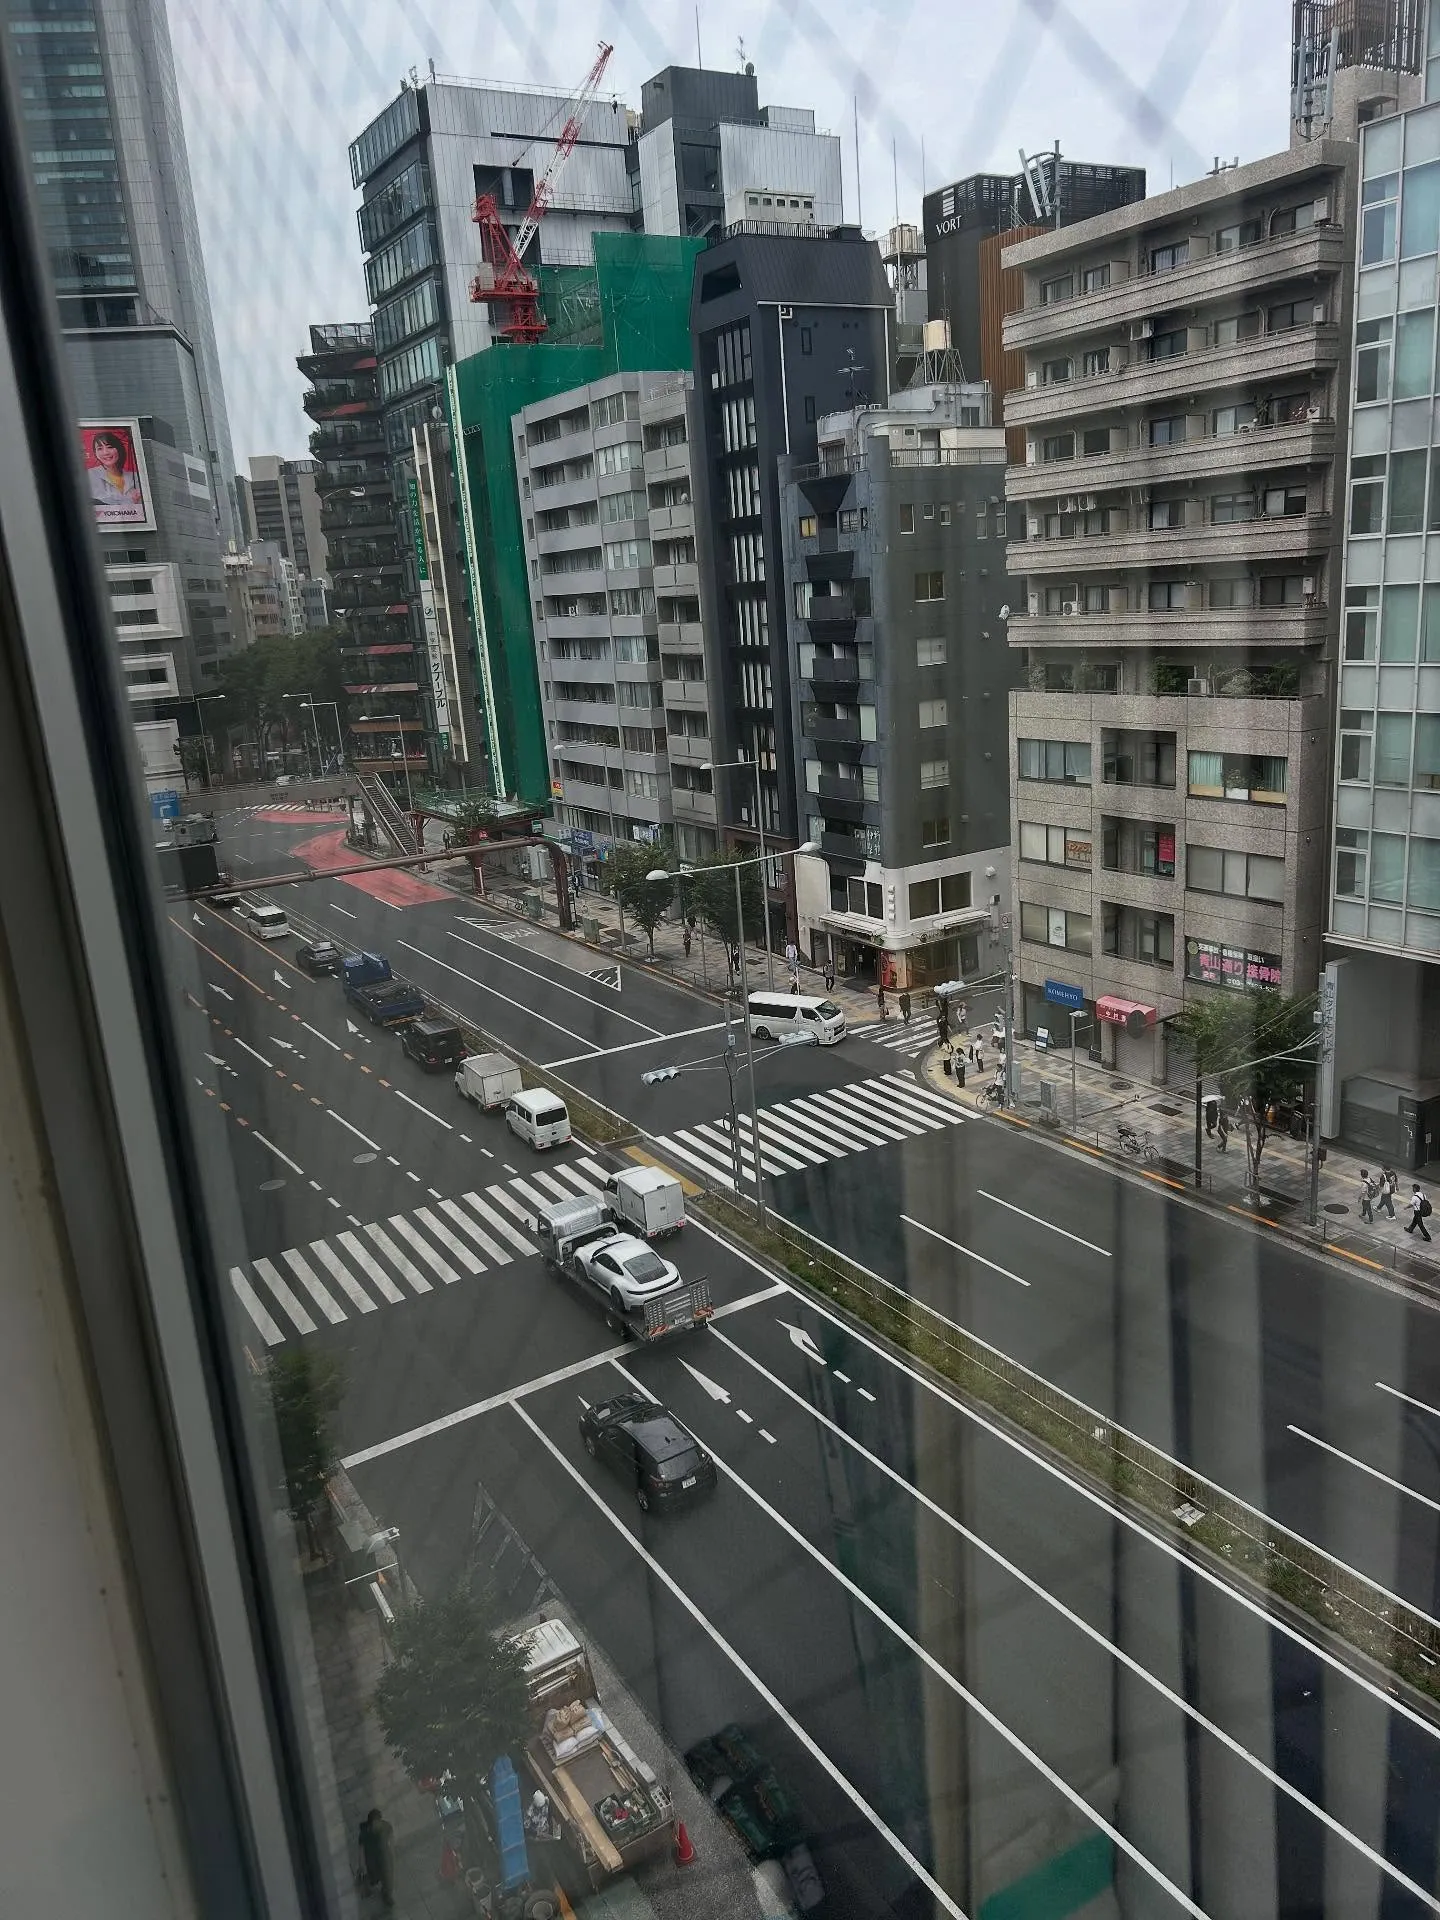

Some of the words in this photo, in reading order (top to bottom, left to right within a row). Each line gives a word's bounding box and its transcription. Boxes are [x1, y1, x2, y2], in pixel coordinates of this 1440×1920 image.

[935, 215, 962, 236] VORT
[104, 509, 138, 517] YOKOHAMA
[1047, 988, 1078, 1001] KOMEHYO
